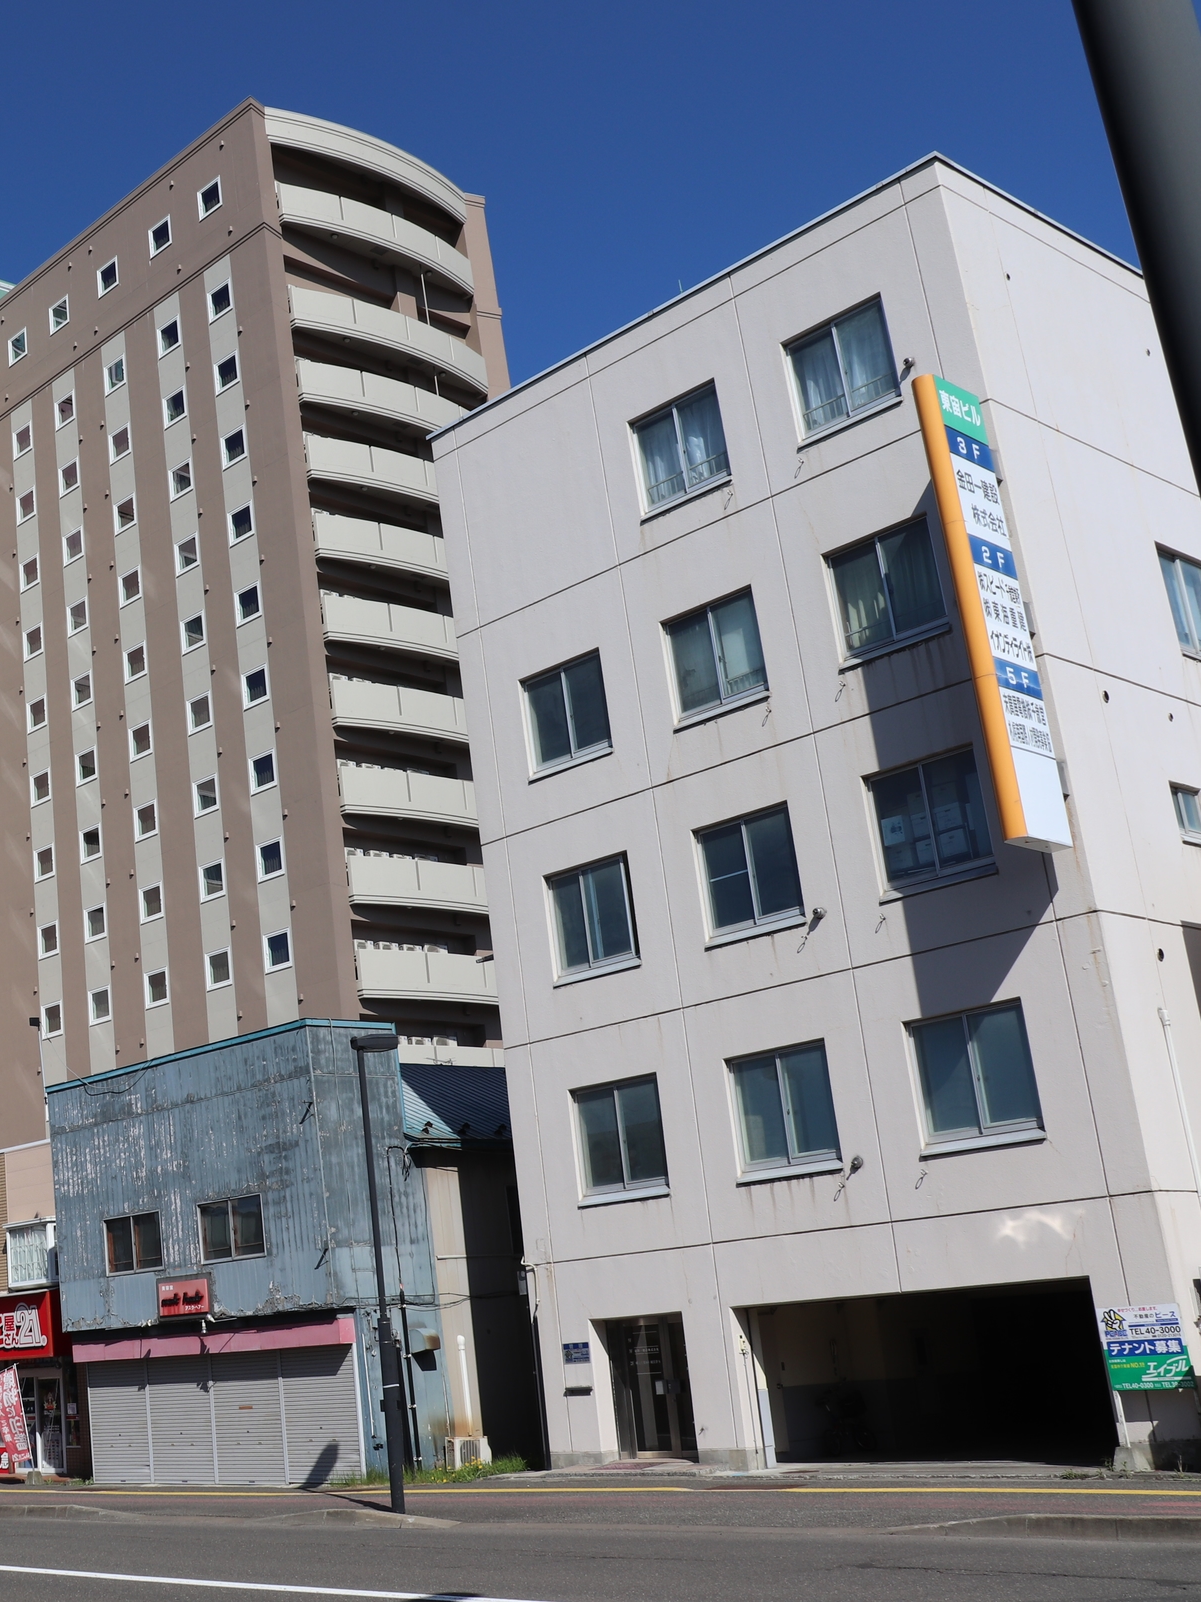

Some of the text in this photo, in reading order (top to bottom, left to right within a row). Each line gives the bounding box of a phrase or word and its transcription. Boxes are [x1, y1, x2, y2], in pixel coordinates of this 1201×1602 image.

[956, 469, 1000, 505] 金田一建設
[971, 503, 1007, 537] 株式会社
[1130, 1326, 1181, 1336] TEL 40-3000
[1109, 1339, 1182, 1356] テナント募集
[1146, 1359, 1190, 1377] エイブル
